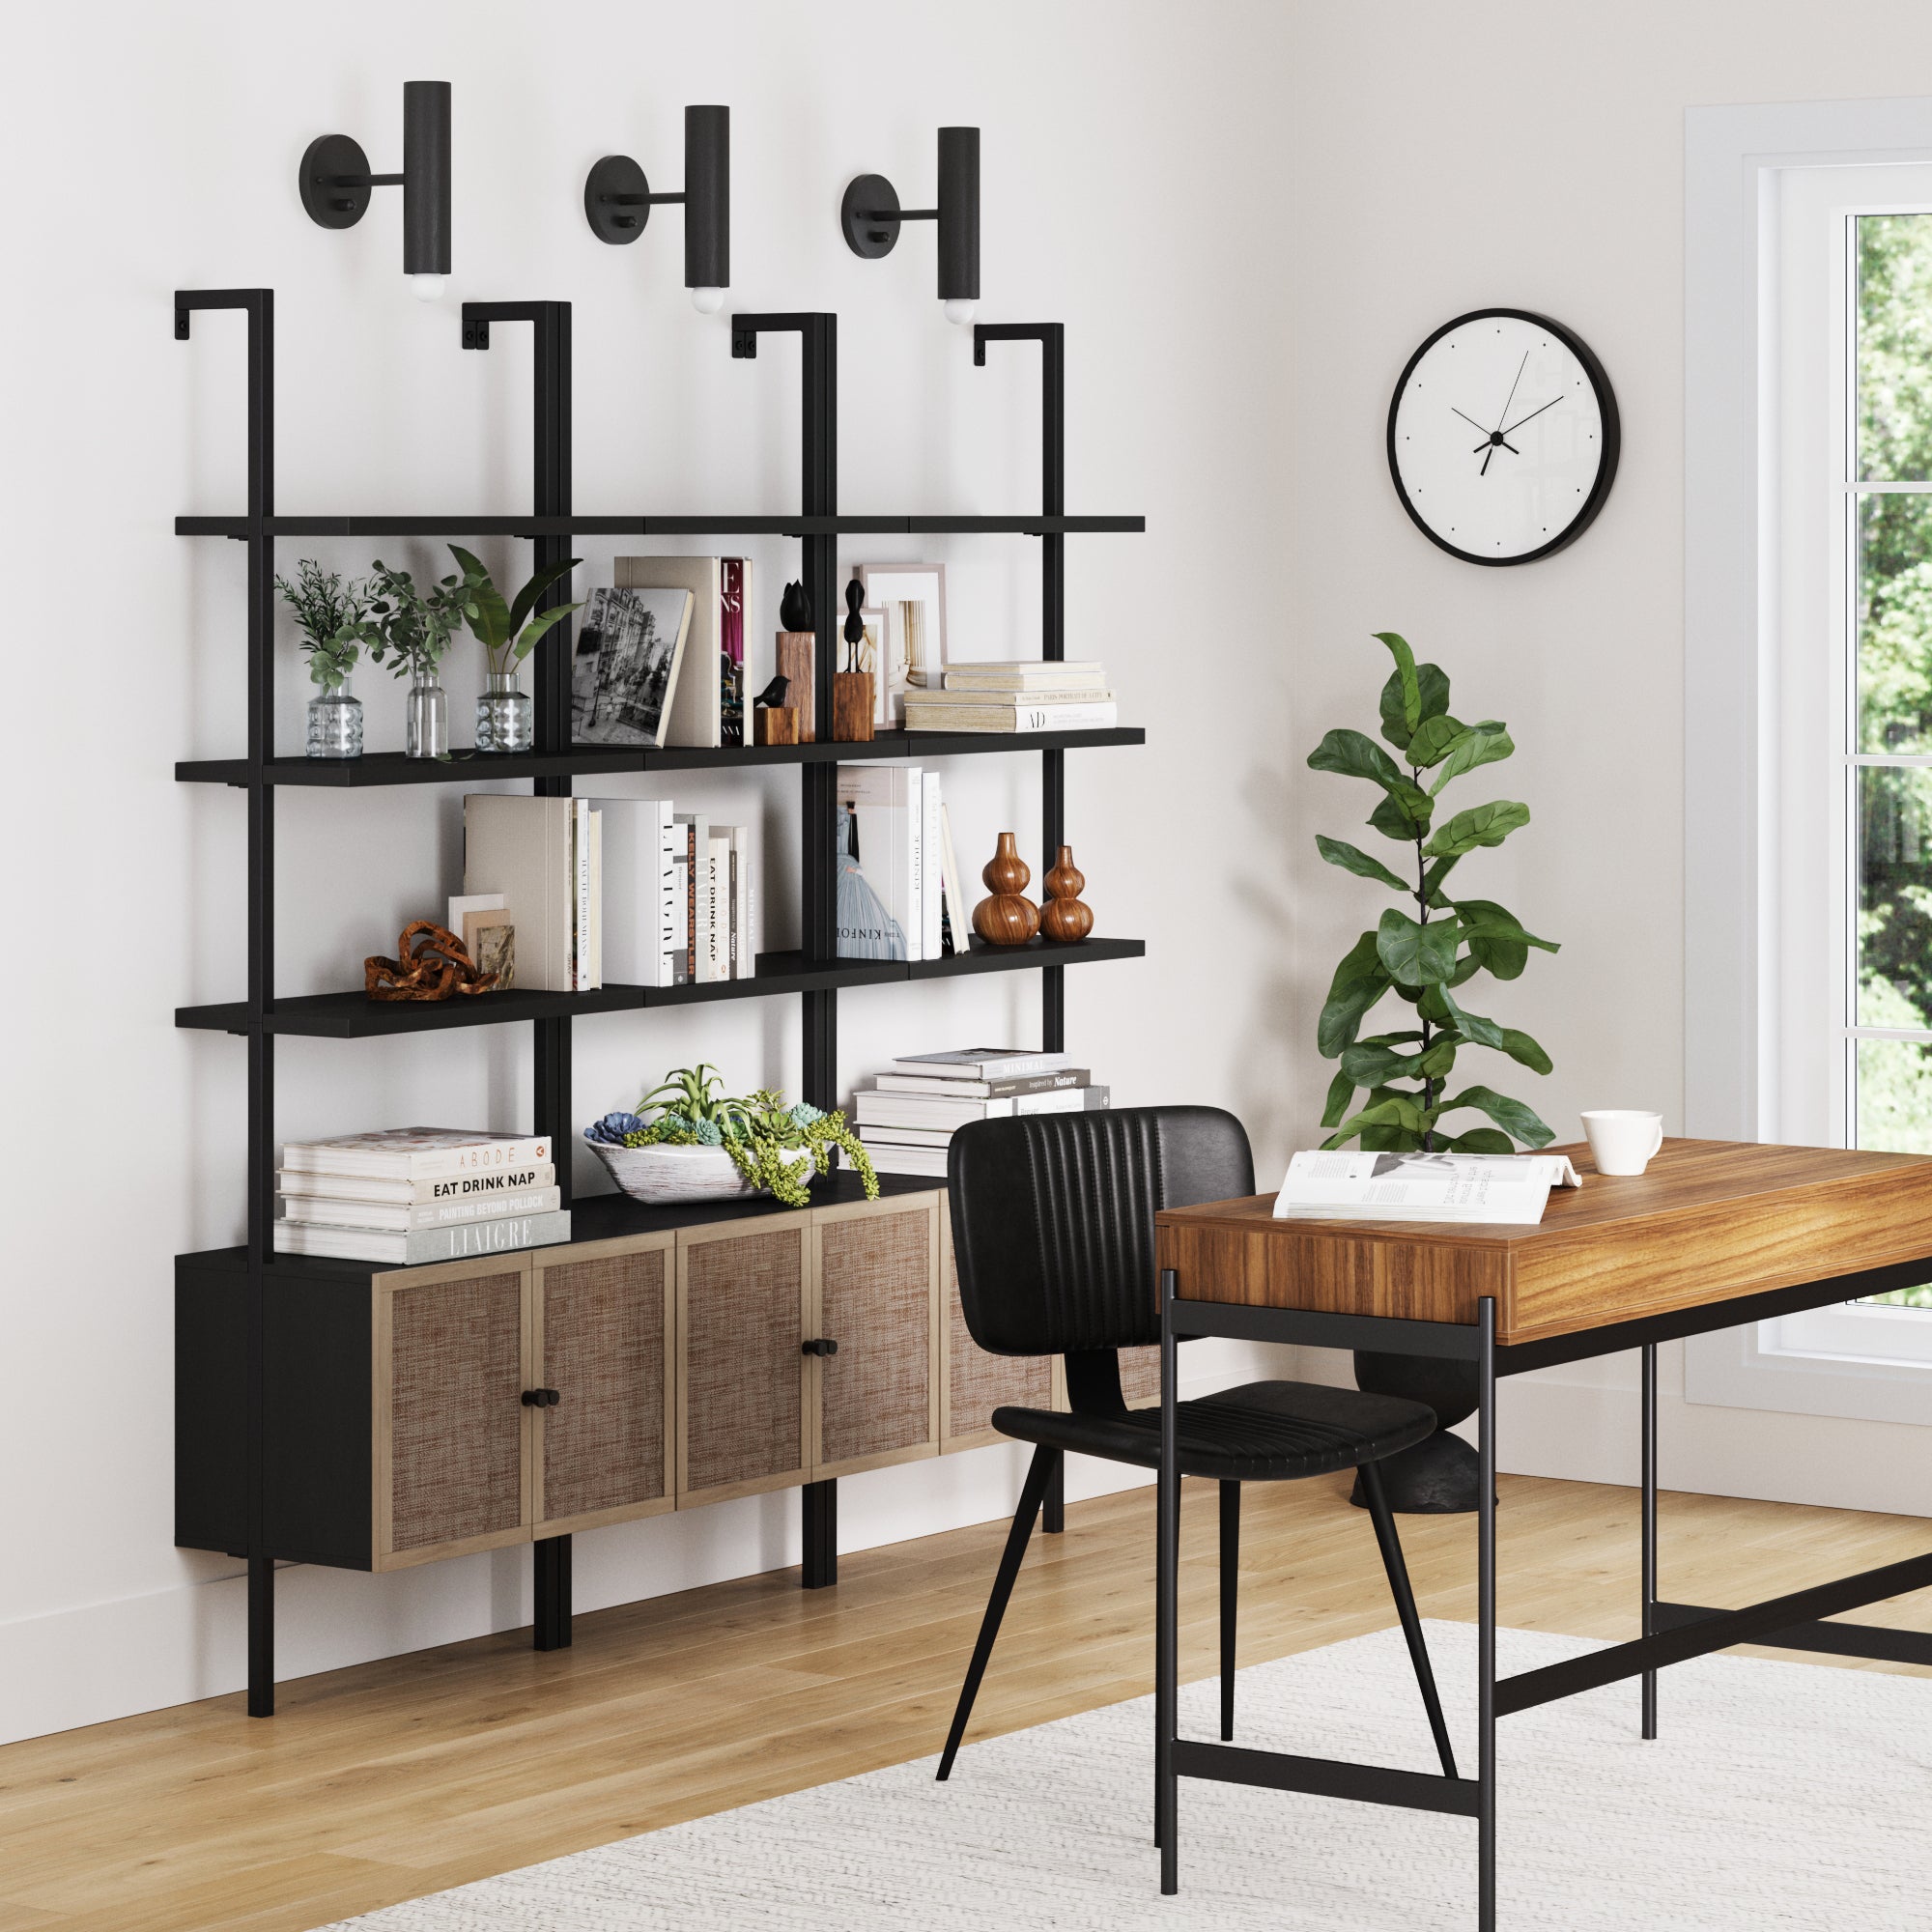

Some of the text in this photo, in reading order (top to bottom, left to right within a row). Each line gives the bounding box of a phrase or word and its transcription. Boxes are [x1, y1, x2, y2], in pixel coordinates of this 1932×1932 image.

[1054, 1076, 1077, 1088] Nature
[460, 1147, 515, 1168] ABODE
[434, 1172, 535, 1197] EAT DRINK NAP
[439, 1207, 475, 1221] PAINTING
[476, 1201, 508, 1216] BEYOND
[509, 1195, 544, 1210] POLLOCK
[450, 1219, 532, 1256] LIAIGRE
